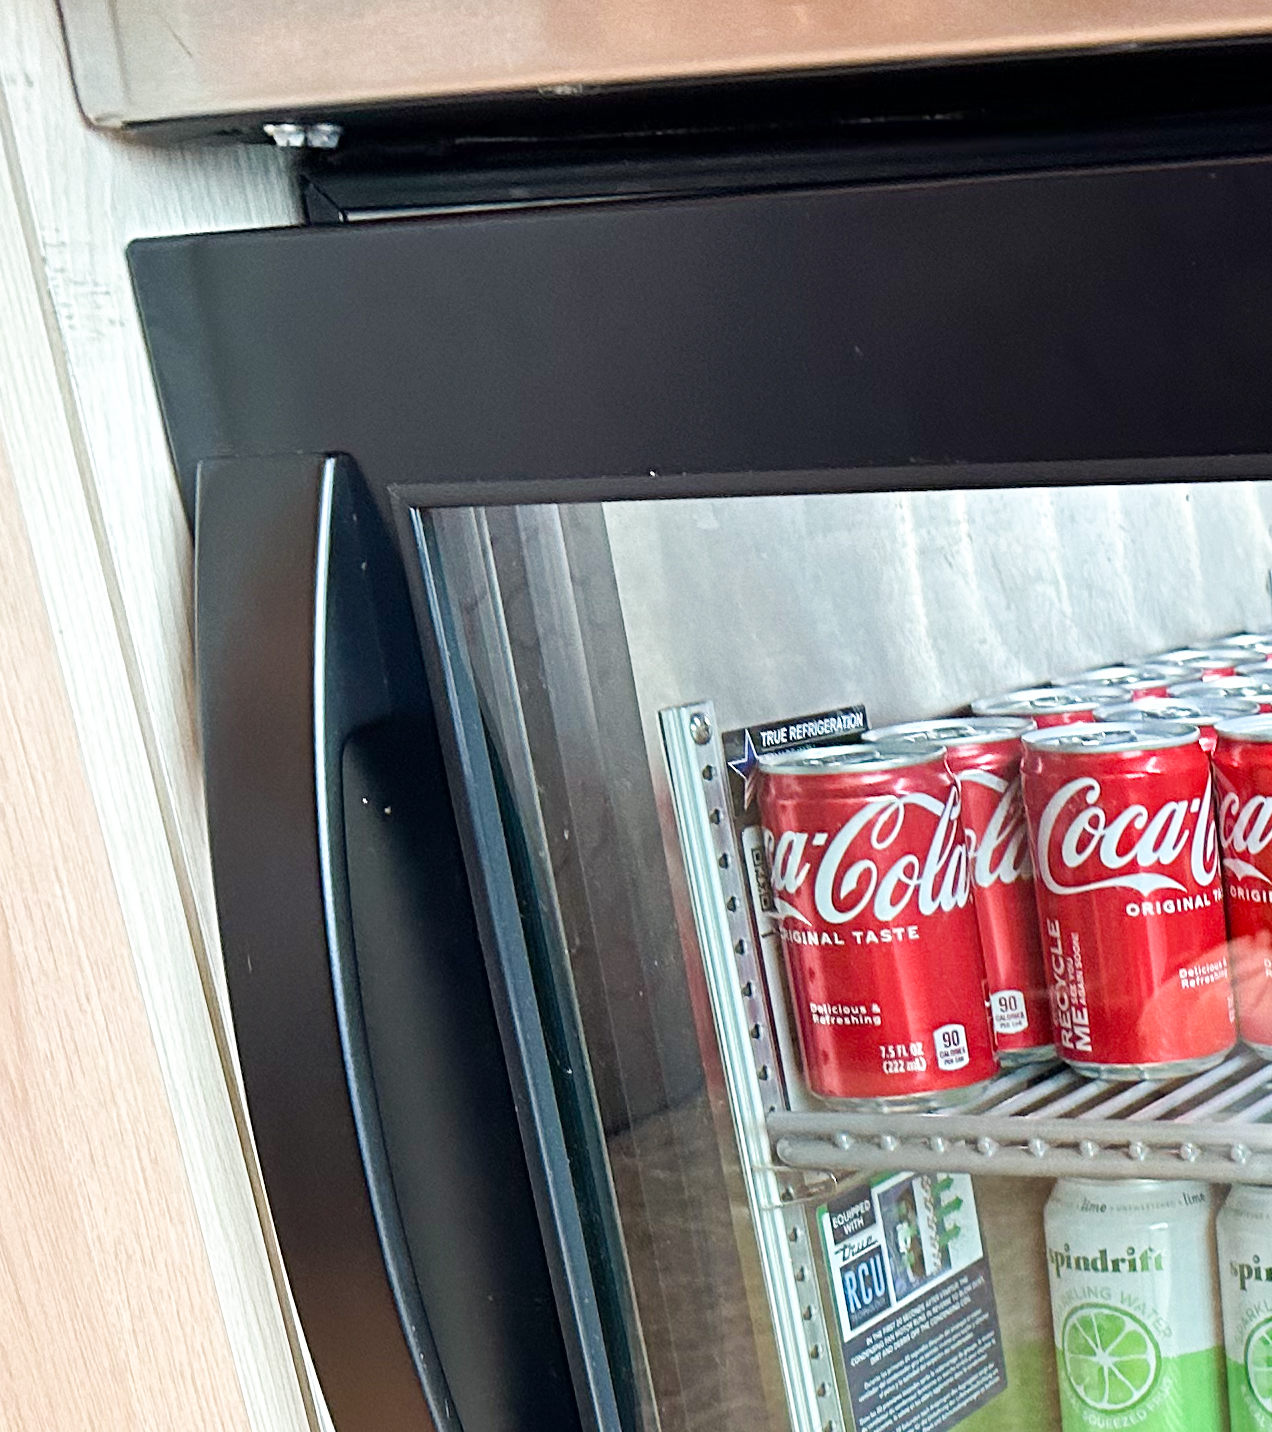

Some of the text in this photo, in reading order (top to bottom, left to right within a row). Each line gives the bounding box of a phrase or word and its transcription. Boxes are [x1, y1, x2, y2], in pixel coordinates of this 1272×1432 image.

[760, 711, 864, 748] TRUE REFRIGERATION
[1126, 893, 1211, 918] ORIGINAL
[780, 925, 920, 946] RIGINAL TASTE
[1047, 918, 1075, 1050] RECYCLE
[810, 1002, 881, 1015] Delicious &
[998, 995, 1018, 1013] 90
[813, 1013, 882, 1026] Refreshing
[1072, 1006, 1093, 1051] ME
[897, 1043, 908, 1057] FL
[909, 1042, 924, 1056] OZ
[942, 1029, 960, 1048] 90
[1080, 1191, 1206, 1214] lime lime
[832, 1199, 872, 1229] EQUIPPED
[843, 1217, 865, 1235] WITH
[844, 1253, 887, 1314] RCU
[1120, 1290, 1173, 1339] WATER
[1082, 1408, 1147, 1430] SQUEEZED
